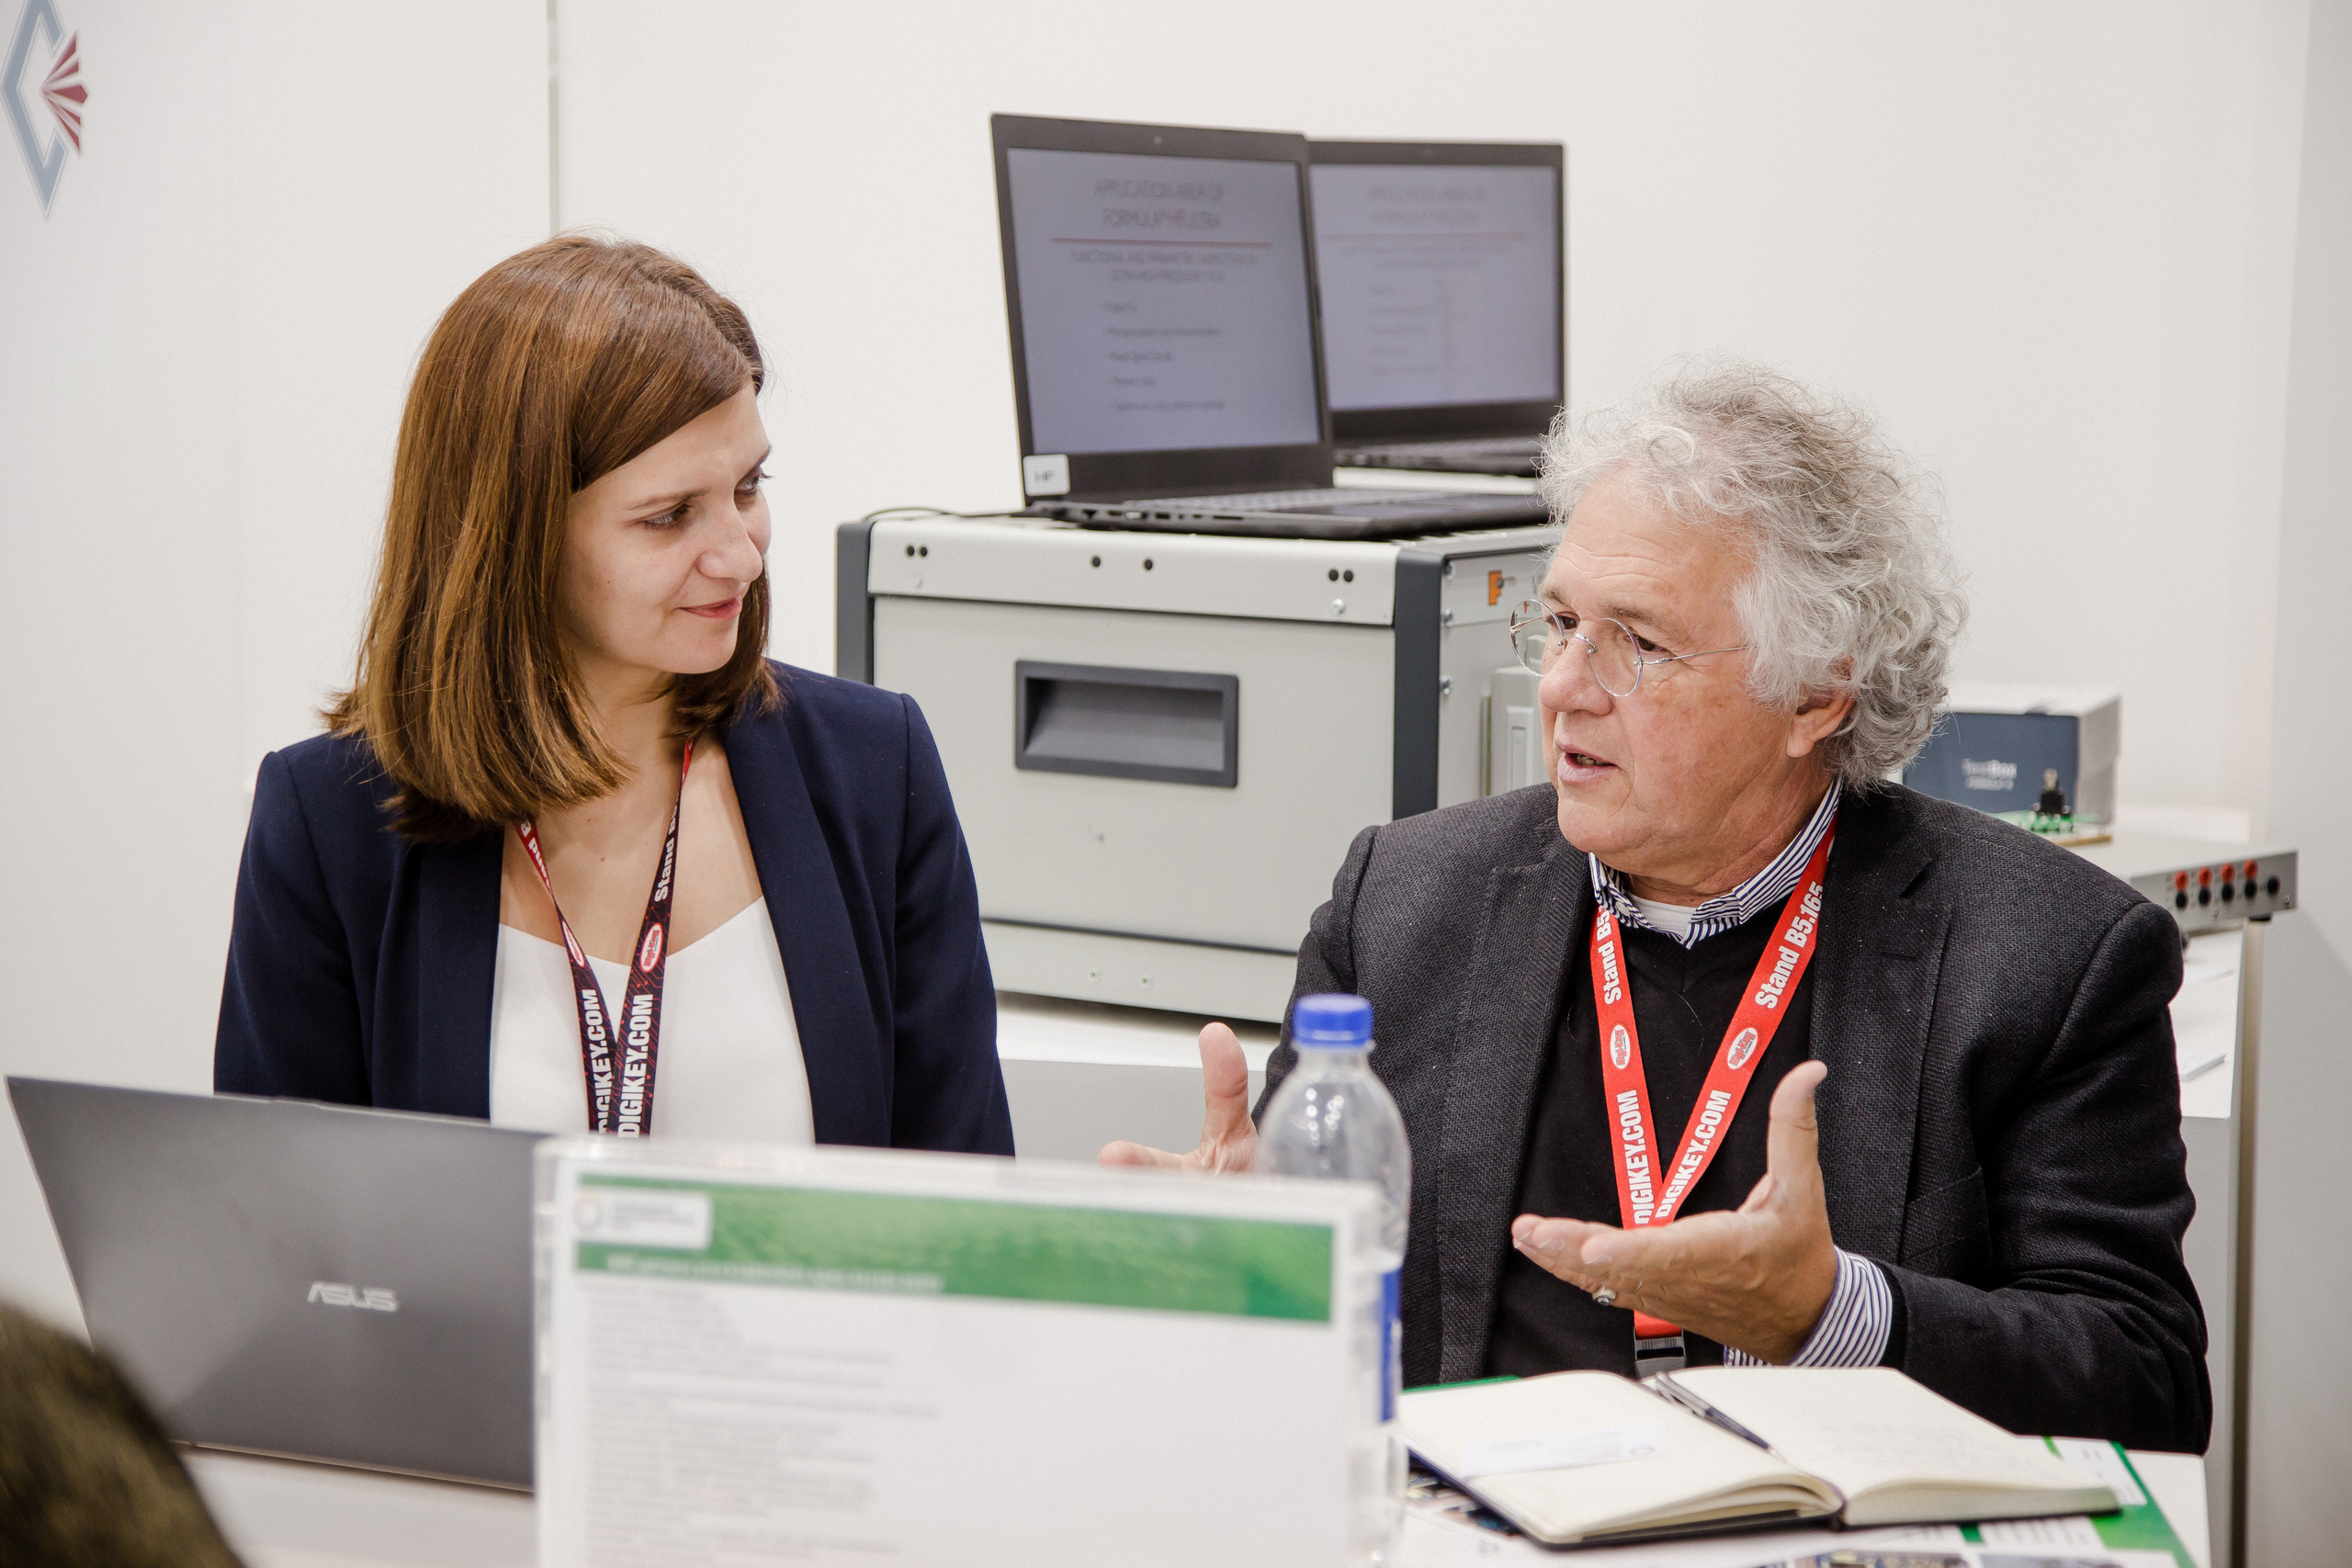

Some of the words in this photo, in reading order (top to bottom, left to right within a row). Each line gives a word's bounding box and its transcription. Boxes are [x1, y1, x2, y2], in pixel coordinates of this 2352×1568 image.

[654, 837, 674, 902] Stand
[1598, 940, 1622, 1005] Stand
[1755, 945, 1800, 1009] Stand
[1783, 880, 1824, 948] B5.165
[617, 994, 653, 1138] DIGIKEY.COM
[1655, 1089, 1732, 1218] DIGIKEY.COM
[306, 1281, 398, 1313] ASUS
